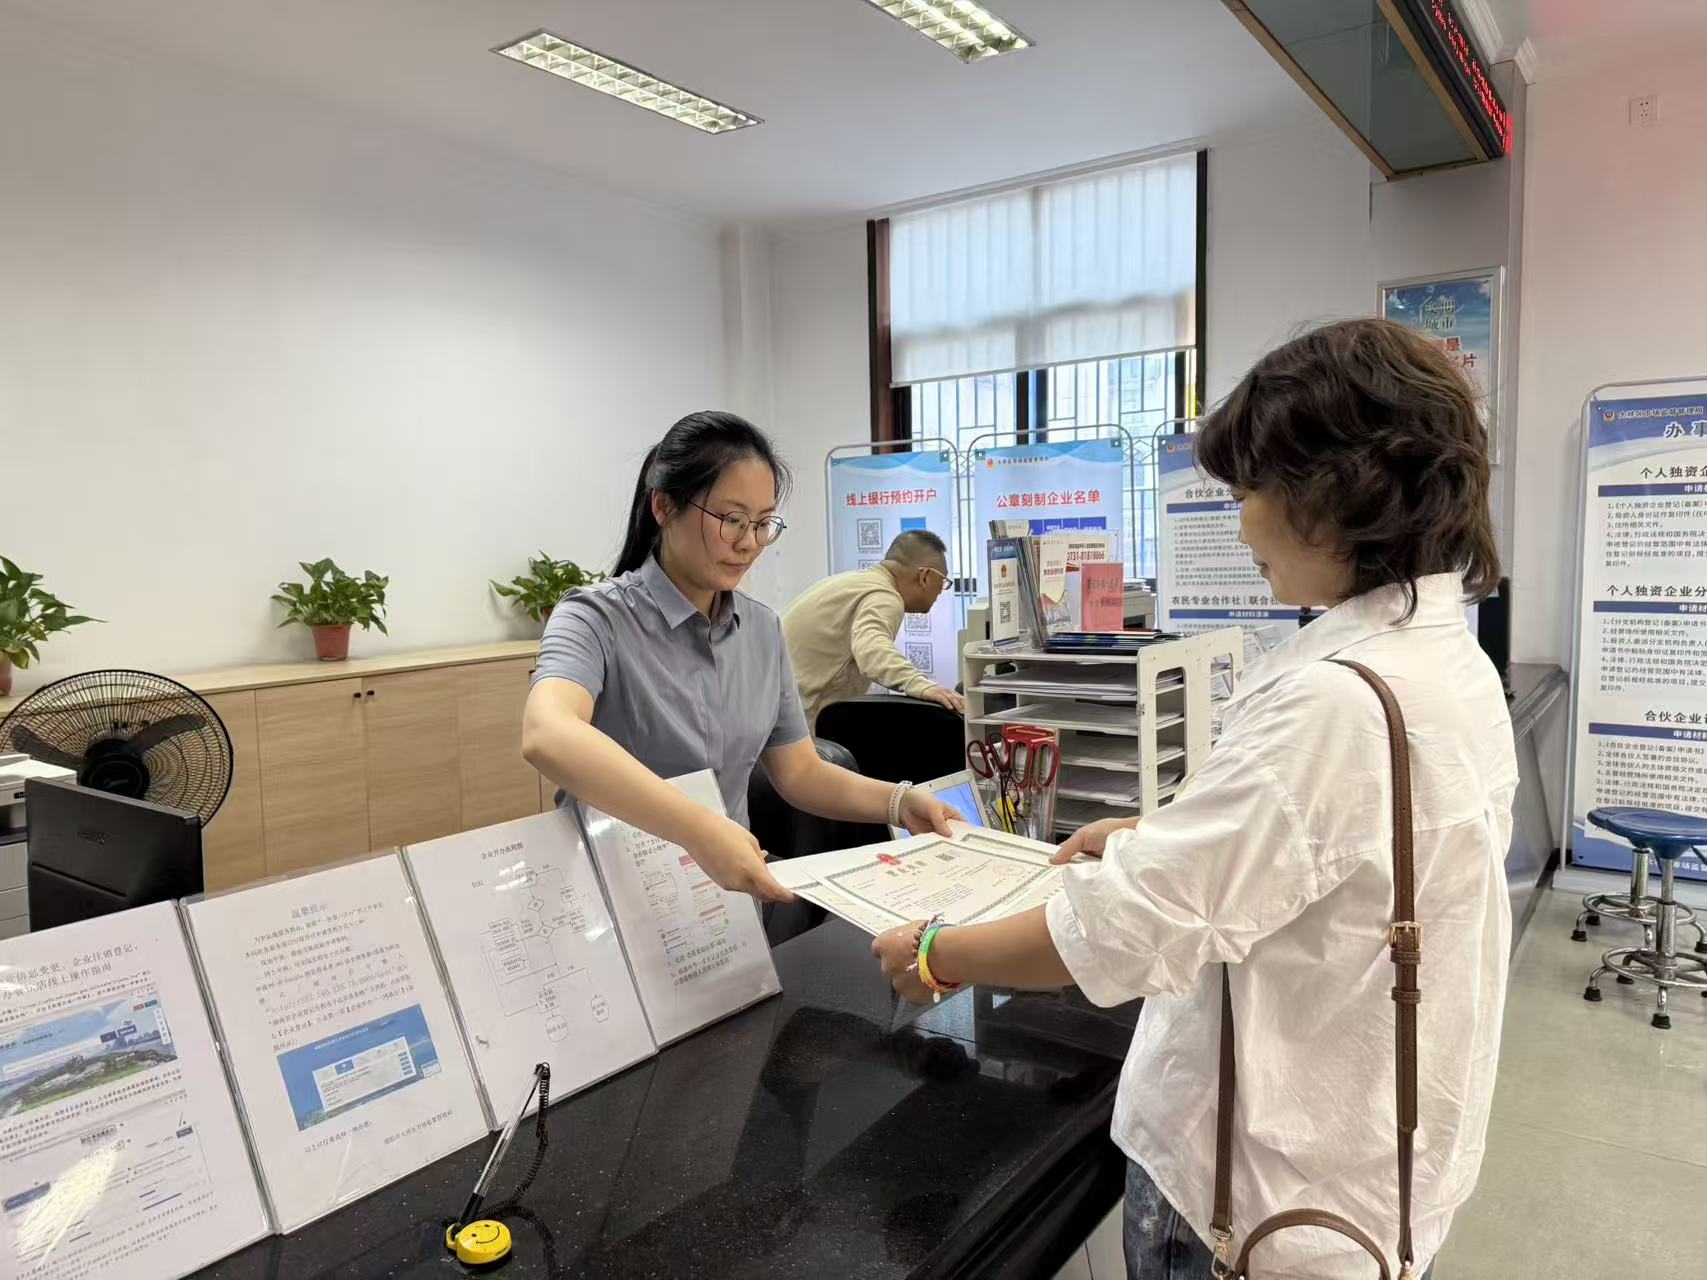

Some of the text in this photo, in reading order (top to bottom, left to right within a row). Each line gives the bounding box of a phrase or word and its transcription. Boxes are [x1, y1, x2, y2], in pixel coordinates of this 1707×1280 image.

[846, 488, 937, 507] 线上银行预约开户
[996, 489, 1101, 508] 公章刻制企业名单
[1607, 585, 1707, 597] 个人独资企业分
